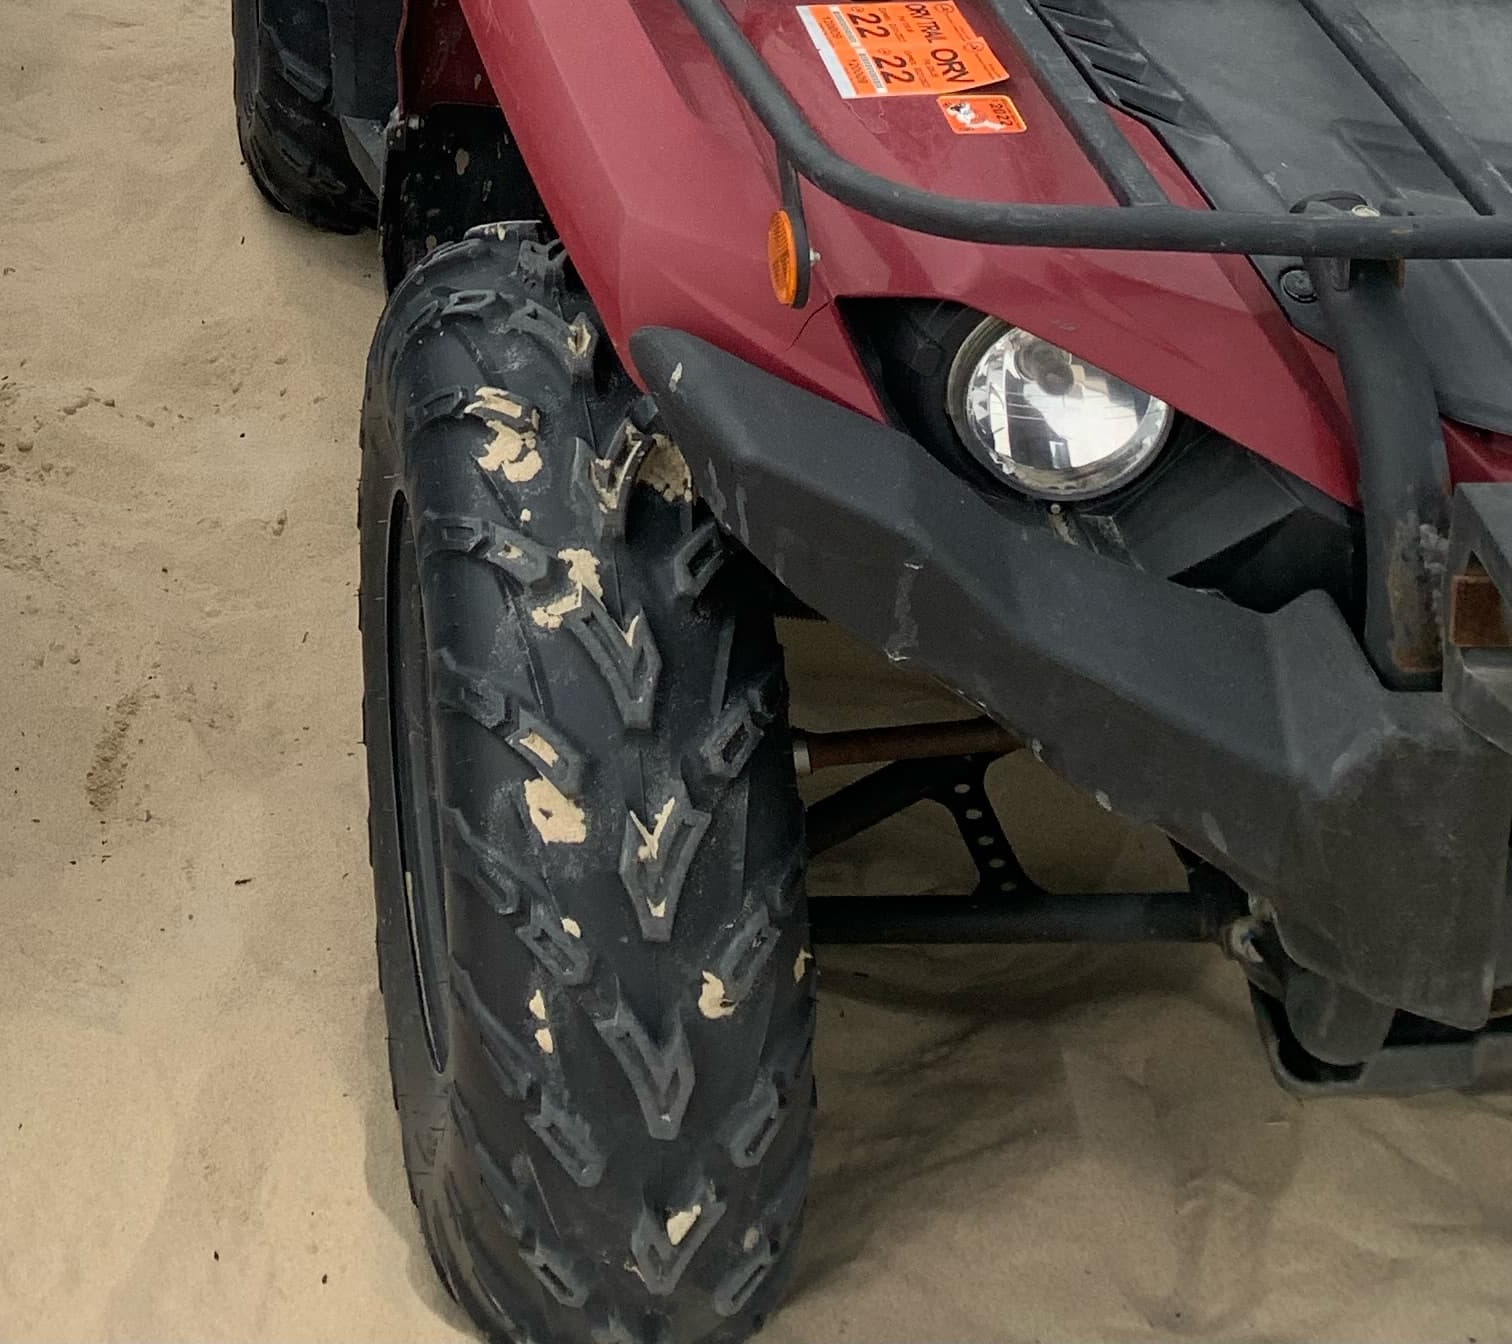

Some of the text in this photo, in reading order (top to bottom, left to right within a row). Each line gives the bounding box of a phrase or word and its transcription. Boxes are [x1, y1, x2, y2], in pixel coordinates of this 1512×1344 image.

[846, 13, 890, 38] 22
[871, 55, 915, 84] 22
[930, 48, 974, 84] ORV
[989, 103, 1013, 127] 2022
